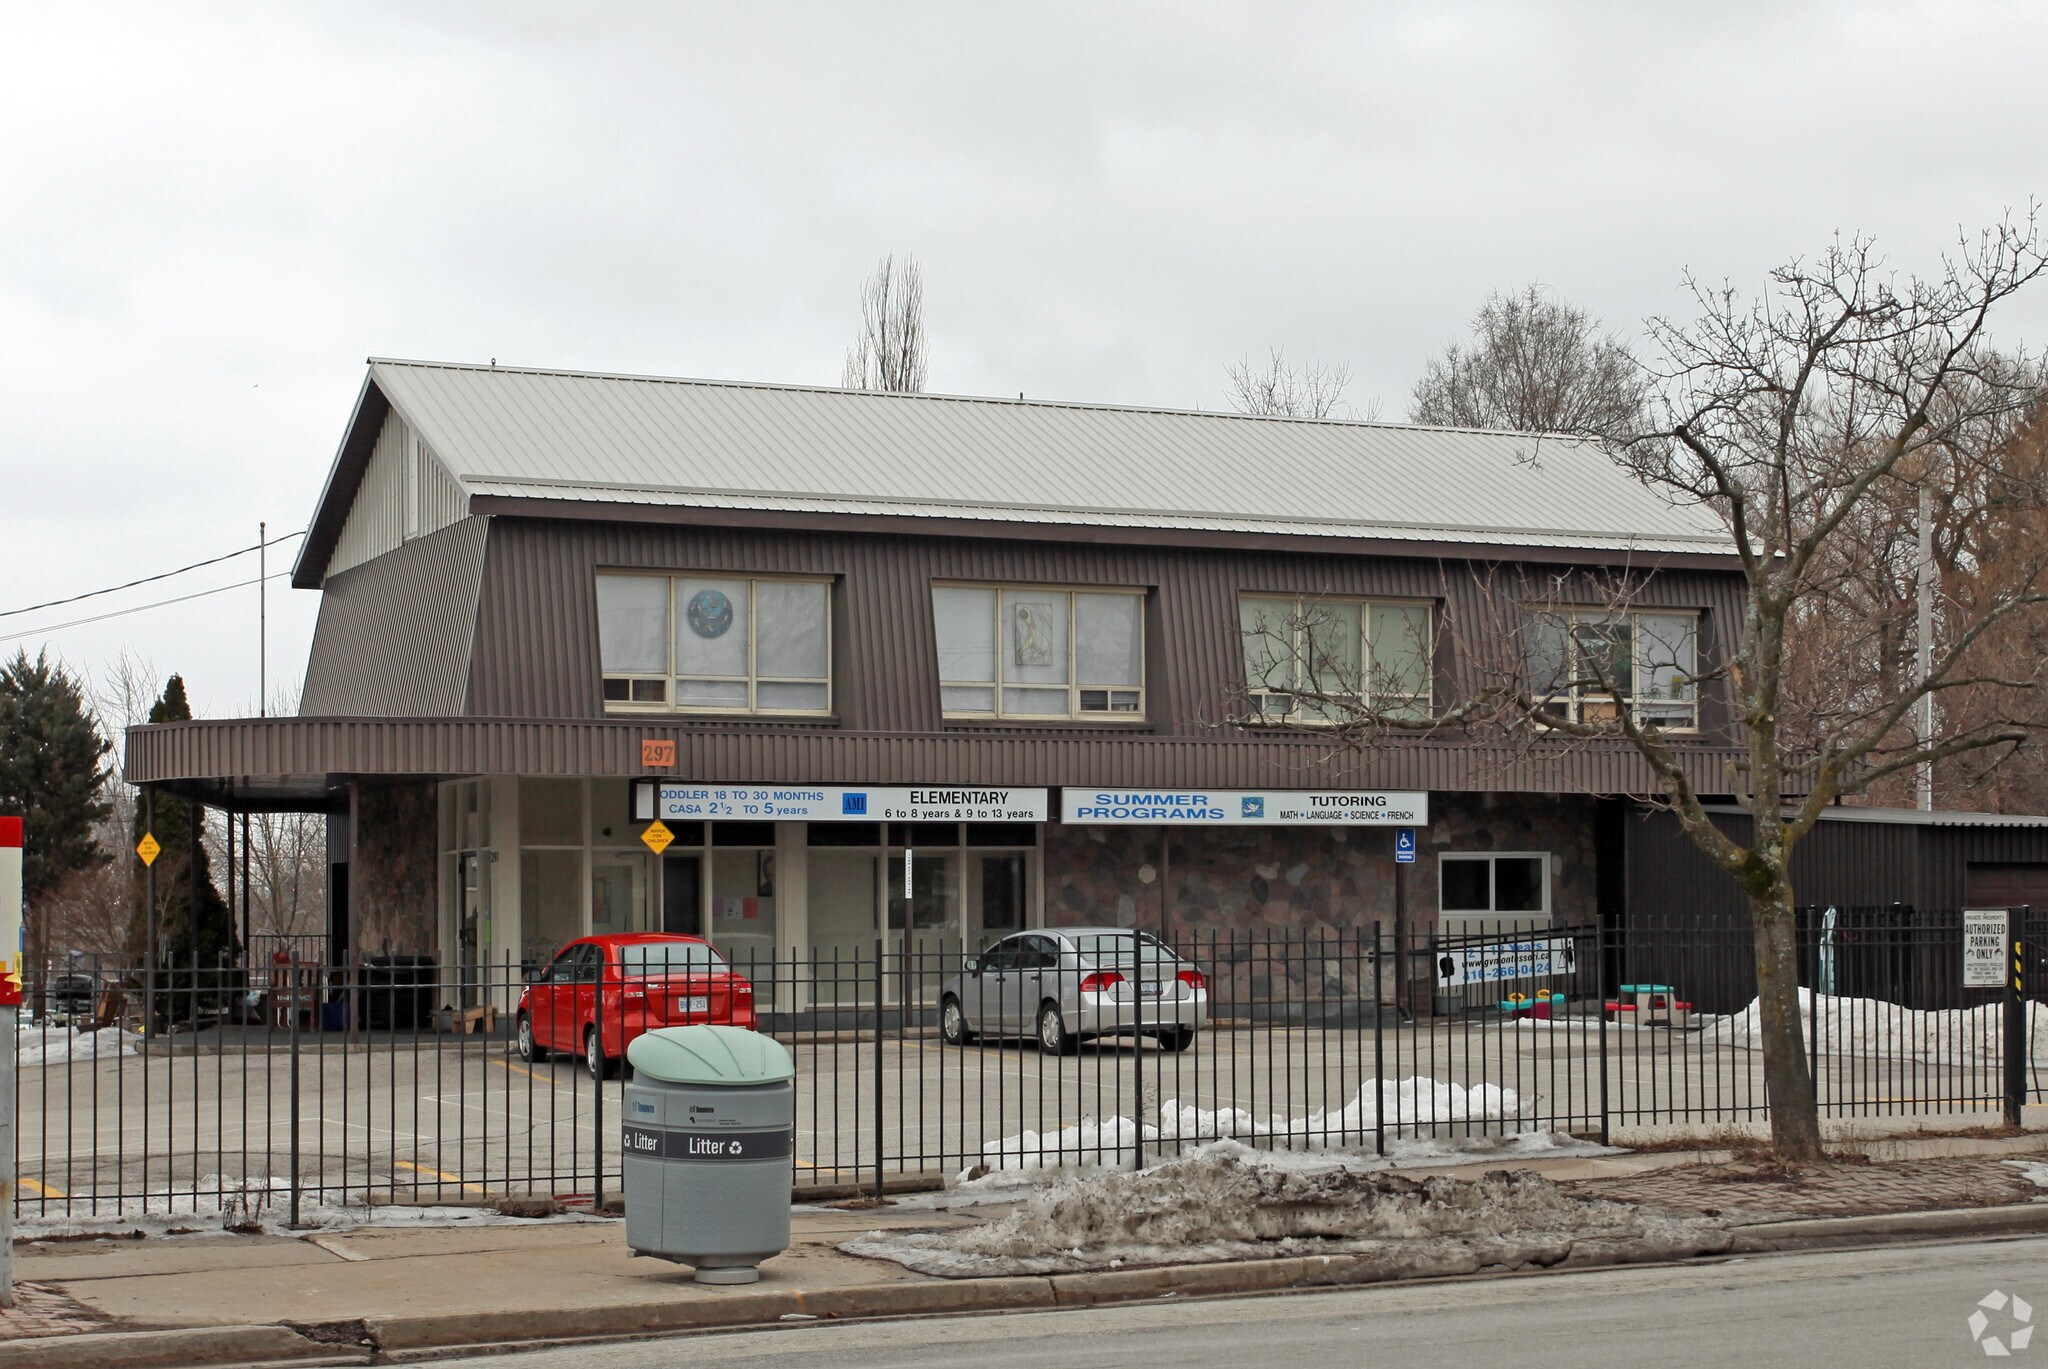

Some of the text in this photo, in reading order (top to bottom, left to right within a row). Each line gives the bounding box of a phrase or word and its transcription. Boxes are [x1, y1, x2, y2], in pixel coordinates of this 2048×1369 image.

[643, 745, 674, 762] 297
[660, 789, 824, 801] ODDLER 18 TO 30 MONTHS
[910, 791, 1009, 804] ELEMENTARY
[1095, 794, 1208, 806] SUMMER
[1309, 795, 1387, 807] TUTORING
[669, 804, 702, 814] CASA
[743, 804, 759, 814] TO
[763, 802, 774, 814] 5
[776, 807, 808, 816] years
[845, 797, 866, 811] AMI
[884, 808, 1034, 819] 6 to 8 years & 9 to 13 years
[1077, 807, 1225, 819] PROGRAMS
[1280, 810, 1414, 820] MATH LANGUAGE SCIENCE FRENCH
[1965, 923, 2006, 935] AUTHORIZED
[1970, 936, 2000, 947] PARKING
[1976, 948, 1993, 959] ONLY
[634, 1132, 658, 1151] Litter
[689, 1137, 726, 1155] Litter
